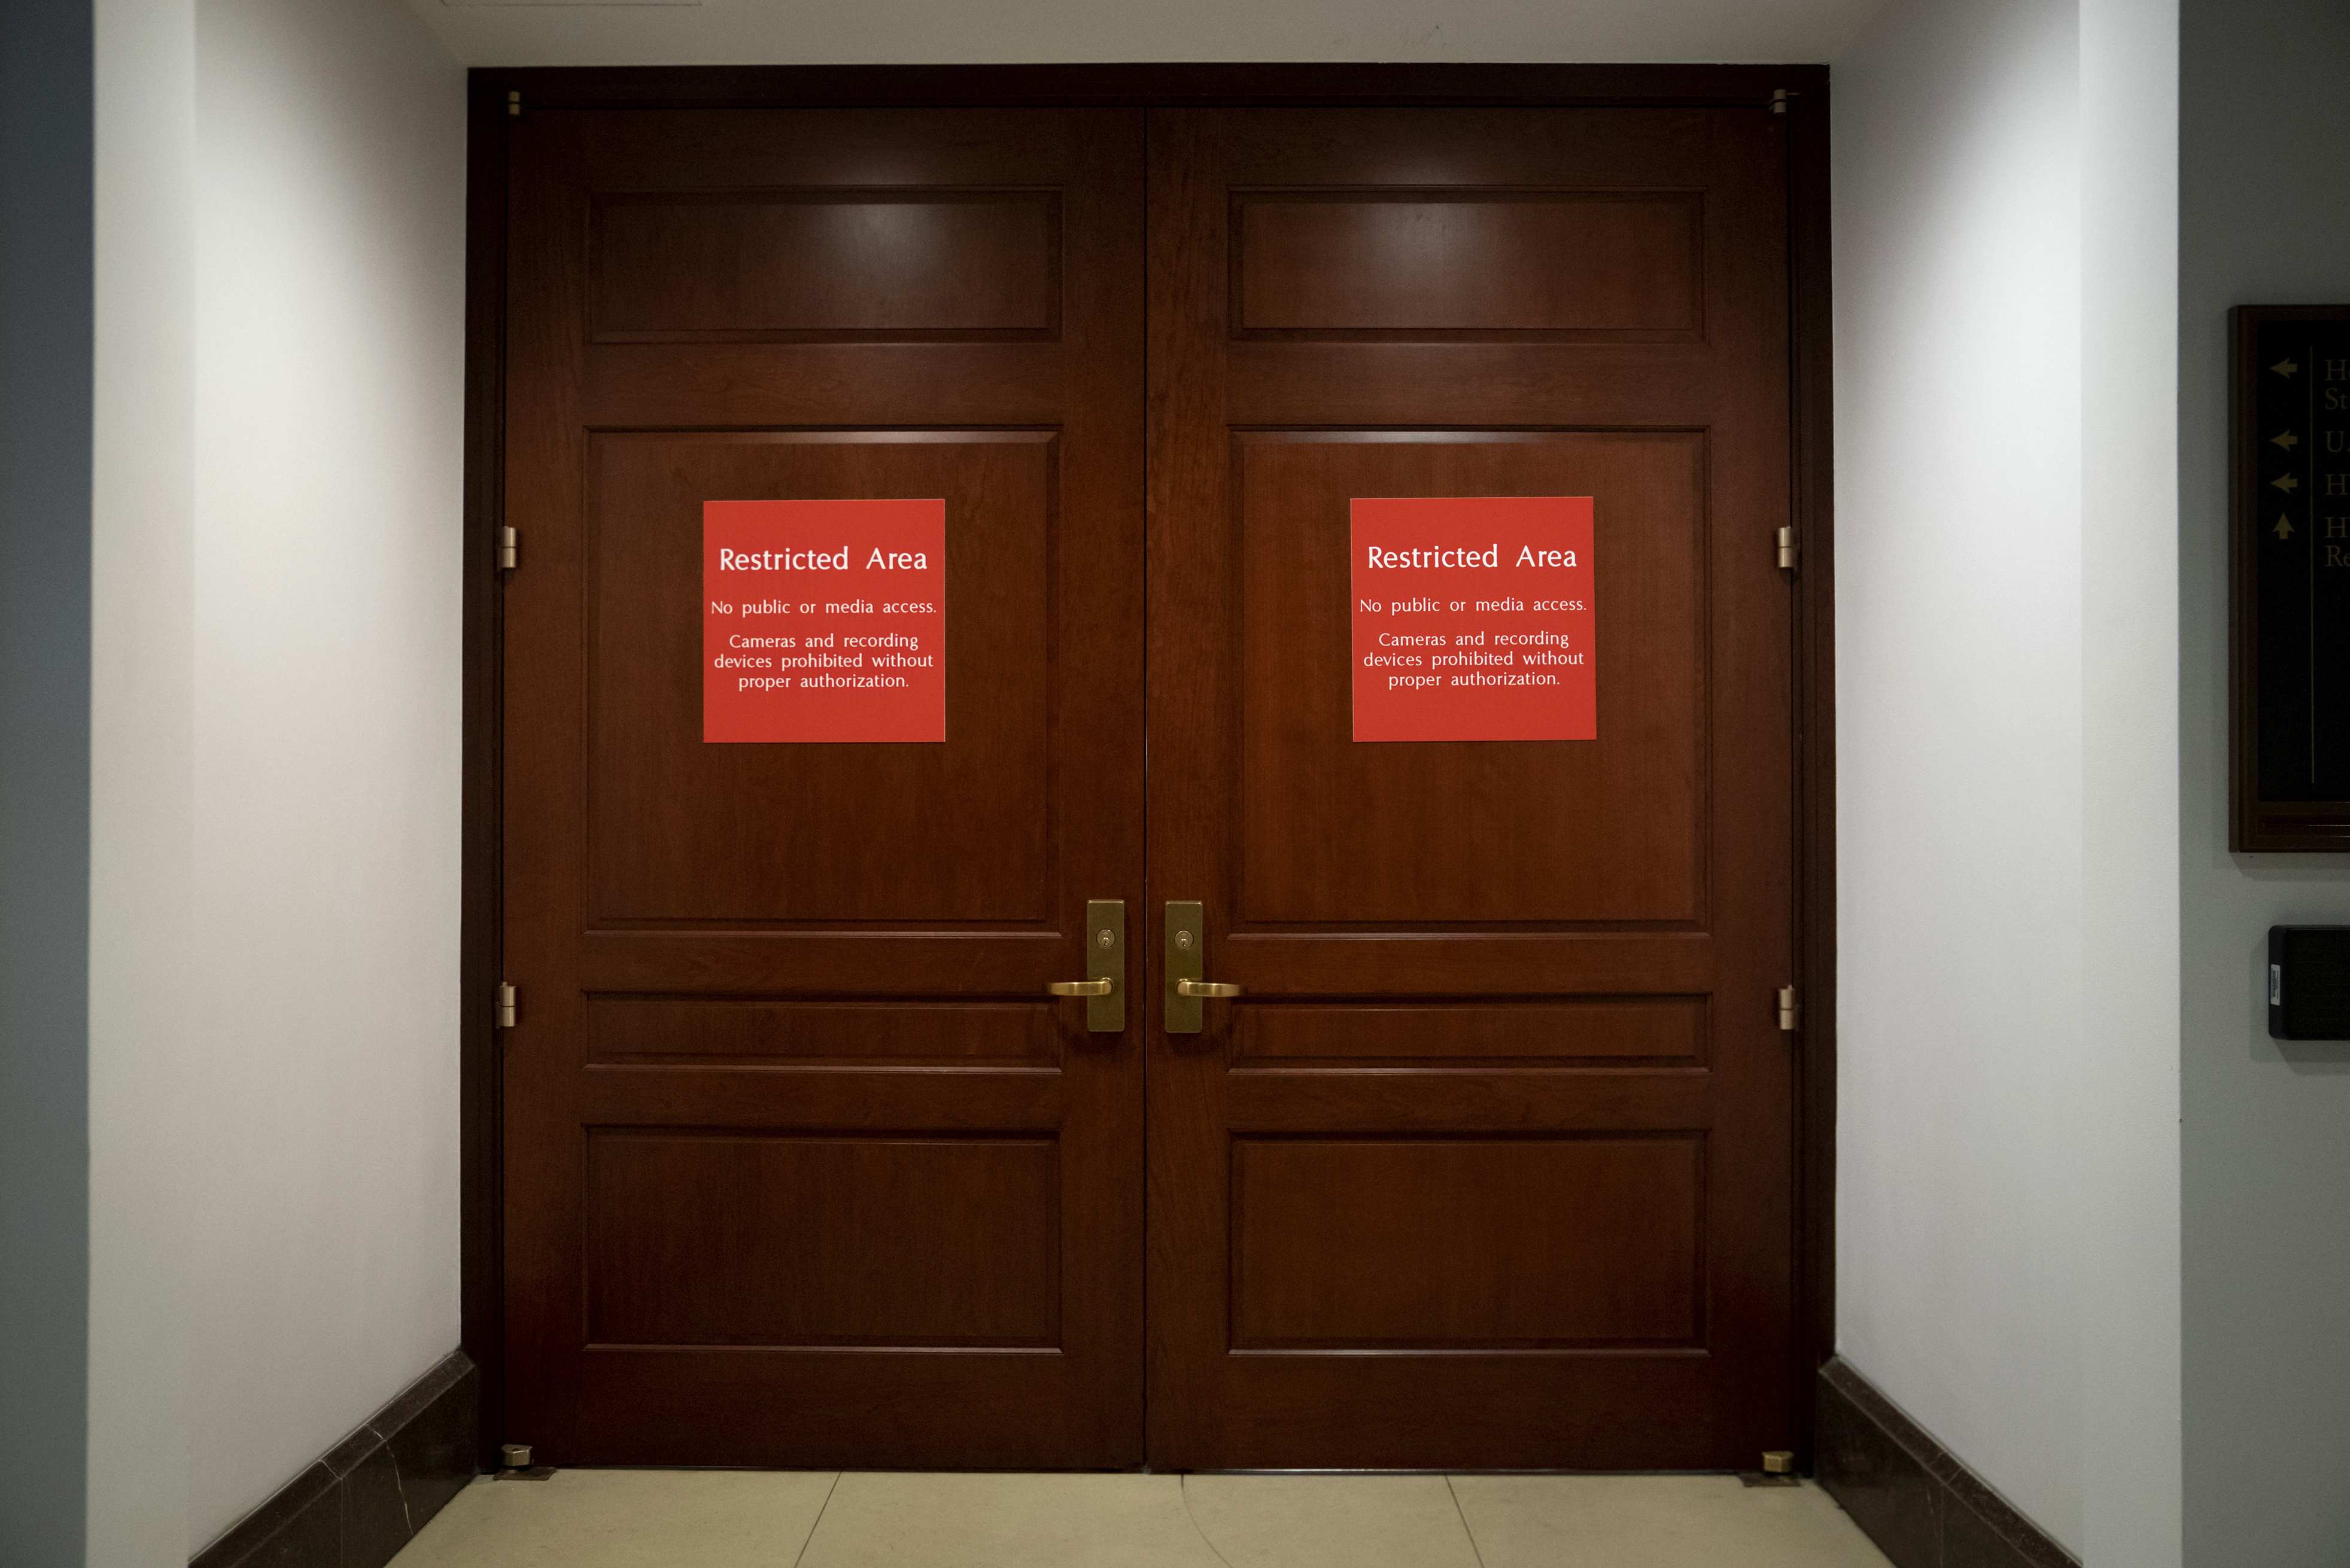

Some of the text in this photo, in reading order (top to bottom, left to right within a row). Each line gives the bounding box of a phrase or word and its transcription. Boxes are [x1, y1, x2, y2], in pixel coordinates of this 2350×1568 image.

[2324, 358, 2350, 381] H
[720, 546, 928, 571] Restricted Area
[1368, 543, 1577, 568] Restricted Area
[711, 599, 937, 618] No public or media access.
[1360, 596, 1586, 616] No public or media access.
[729, 632, 919, 651] Cameras and recording
[1378, 630, 1569, 649] Cameras and recording
[714, 652, 934, 672] devices prohibited without
[1363, 650, 1585, 670] devices prohibited without
[738, 673, 909, 692] proper authorization.
[1388, 671, 1560, 690] proper authorization.
